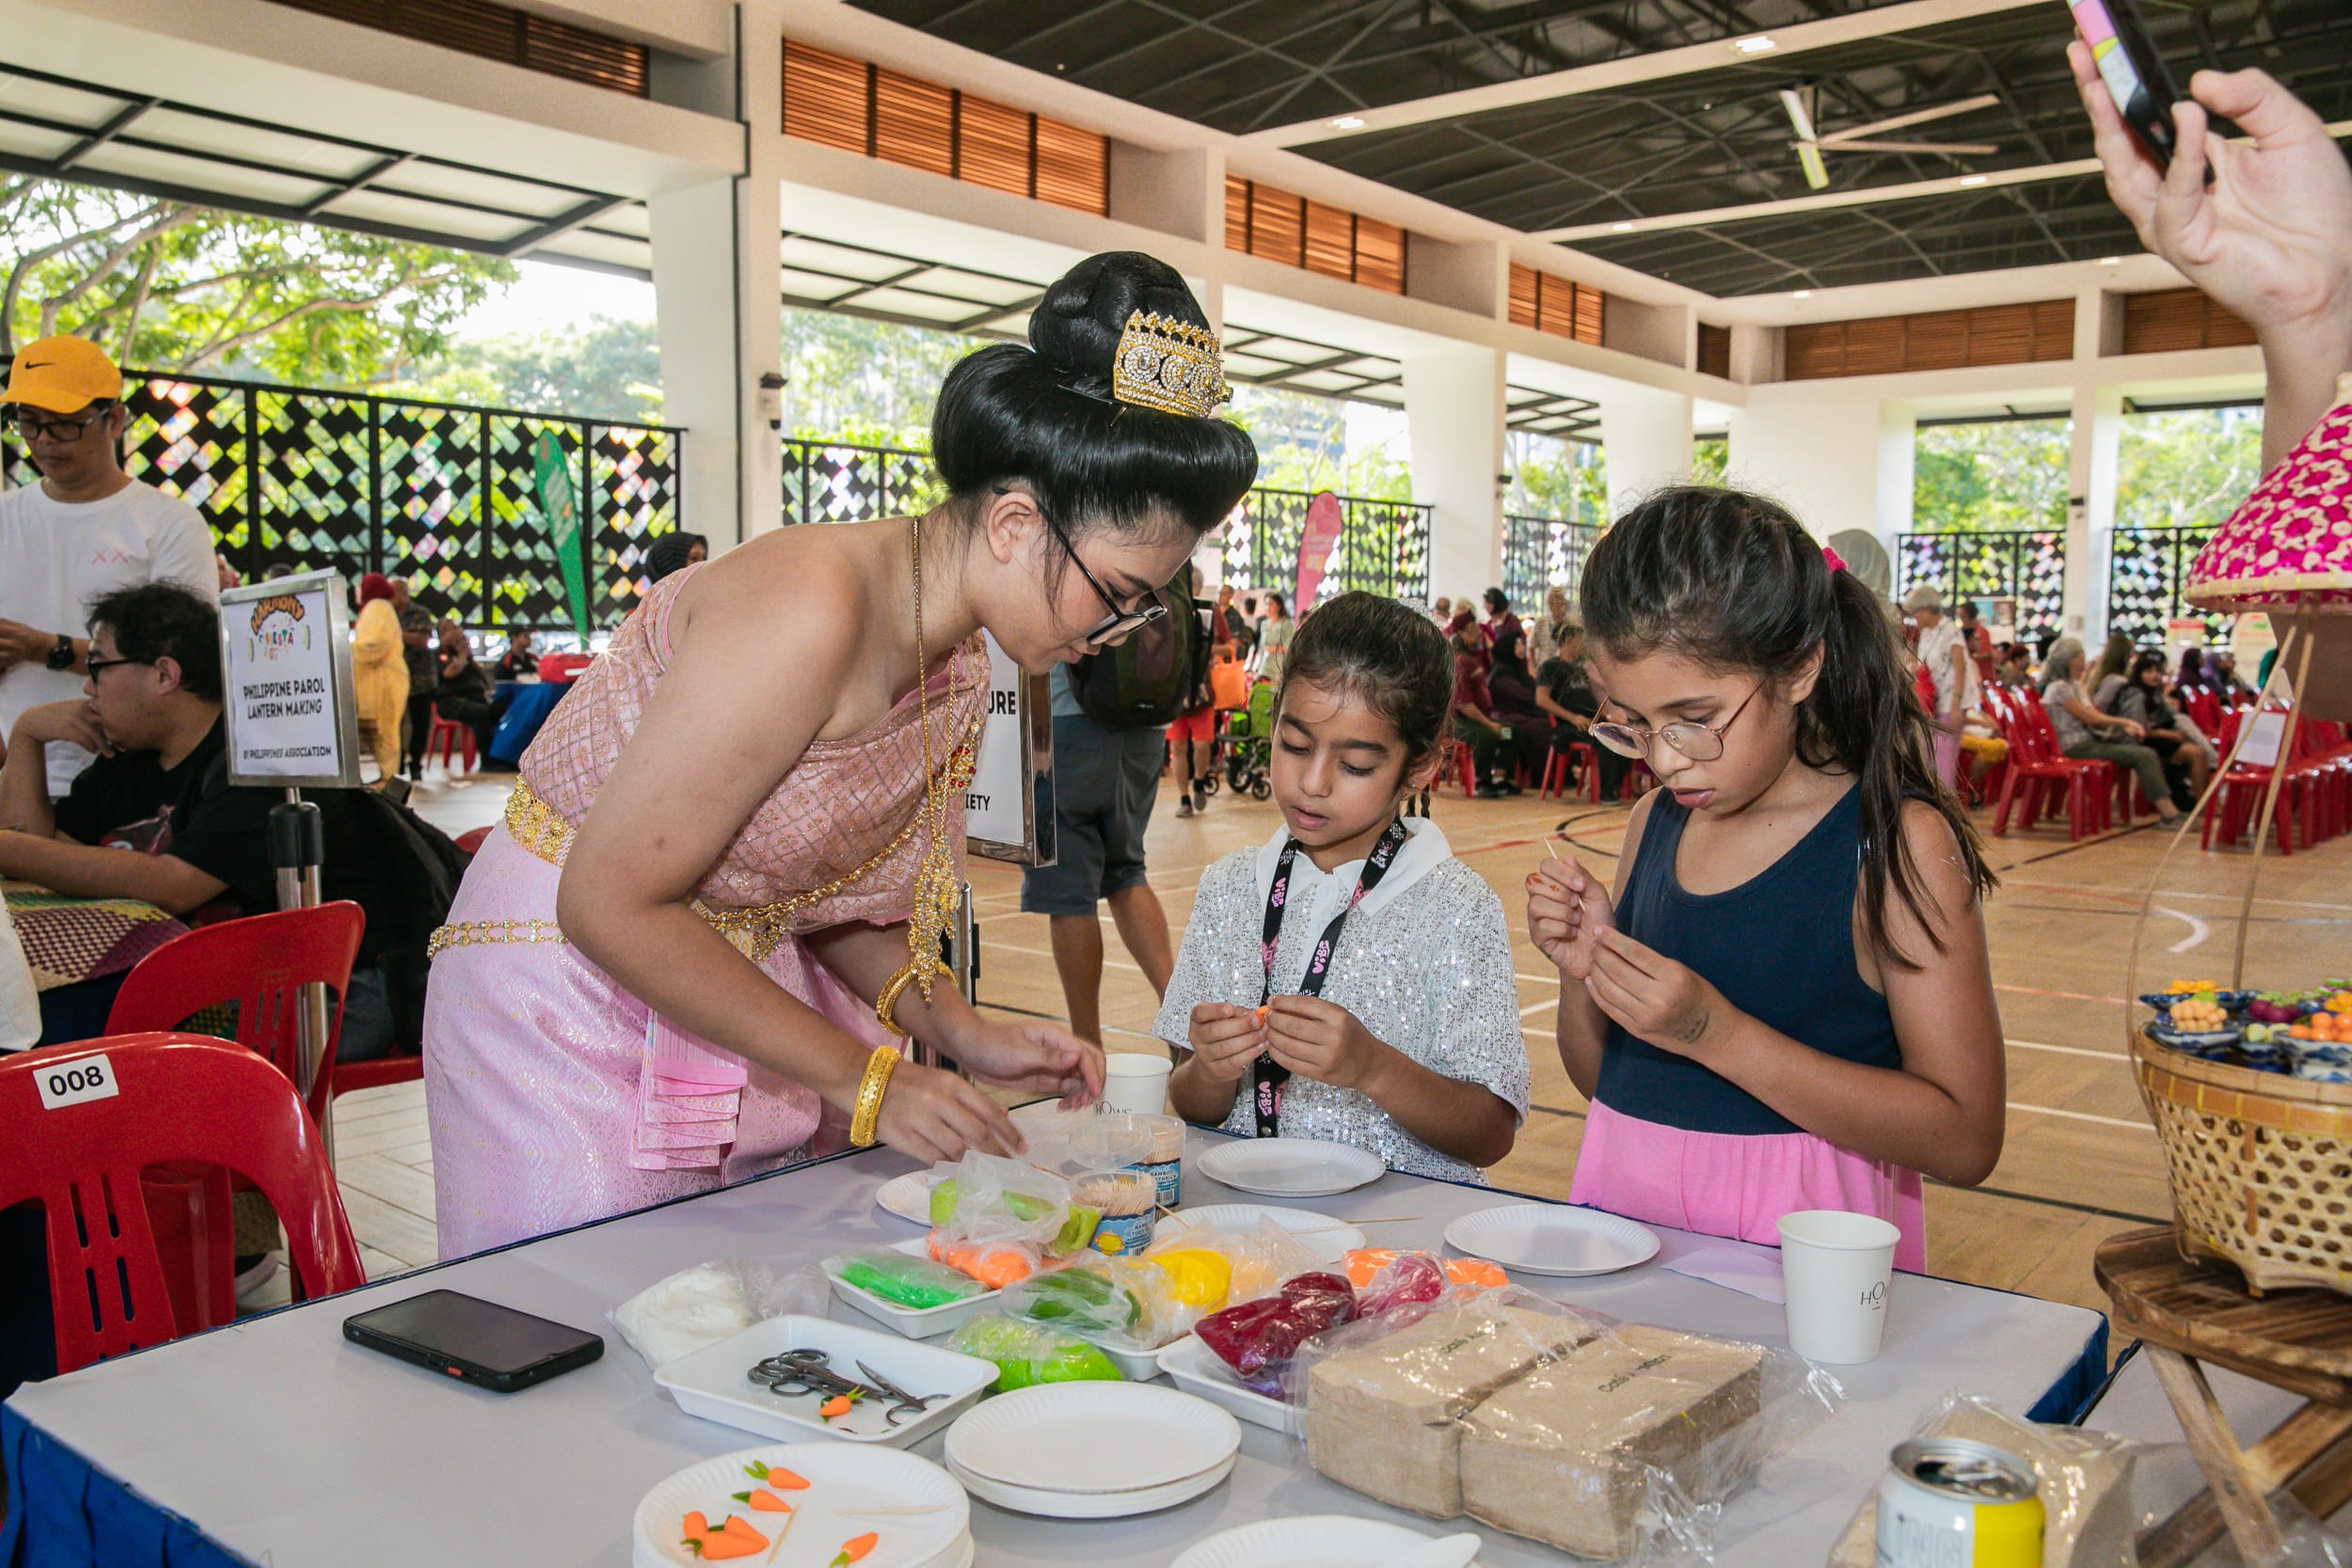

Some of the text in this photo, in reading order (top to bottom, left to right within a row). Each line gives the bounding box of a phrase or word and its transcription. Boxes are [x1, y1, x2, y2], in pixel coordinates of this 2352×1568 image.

[243, 677, 326, 699] PHILIPPINE PAROL
[247, 699, 323, 720] LANTERN MAKING
[284, 746, 332, 757] ASSOCIATION
[49, 1066, 104, 1096] 008
